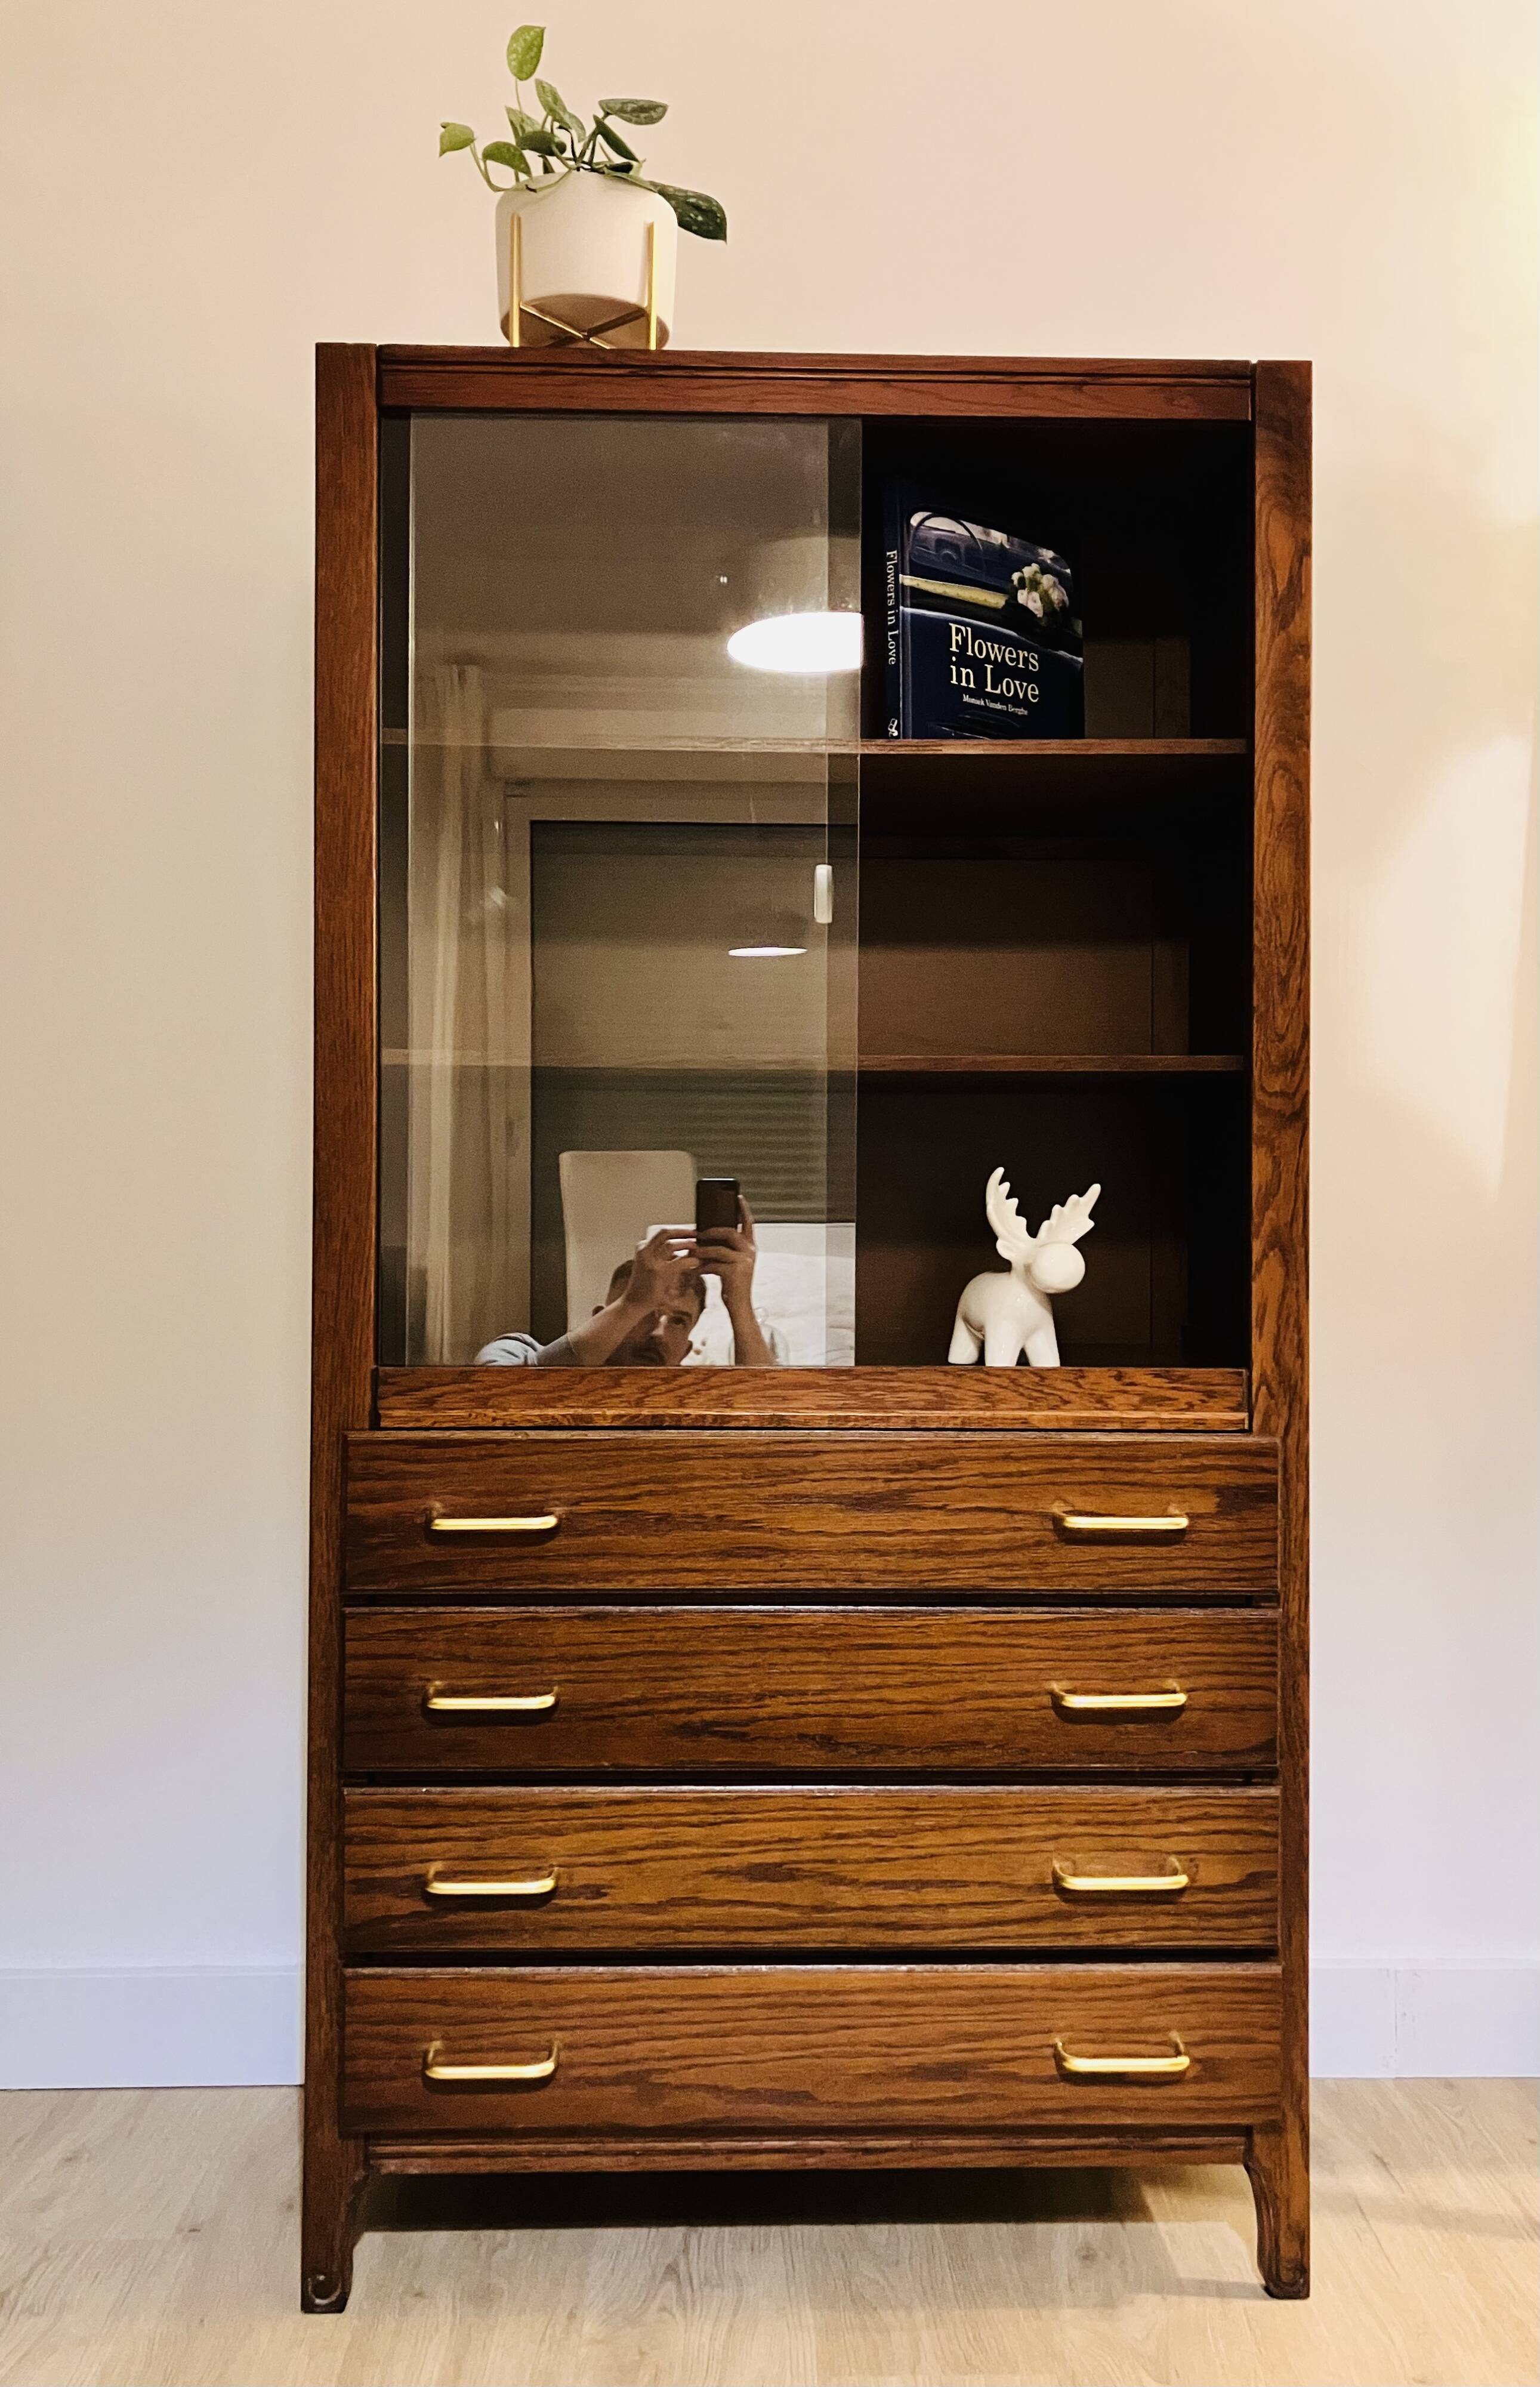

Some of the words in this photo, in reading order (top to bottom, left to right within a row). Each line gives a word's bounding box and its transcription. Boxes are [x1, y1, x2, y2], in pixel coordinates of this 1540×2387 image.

[887, 550, 898, 606] Flowers
[887, 610, 899, 625] in
[888, 630, 899, 665] Love
[949, 622, 1039, 671] Flowers
[950, 656, 976, 689] in
[985, 664, 1039, 702] Love
